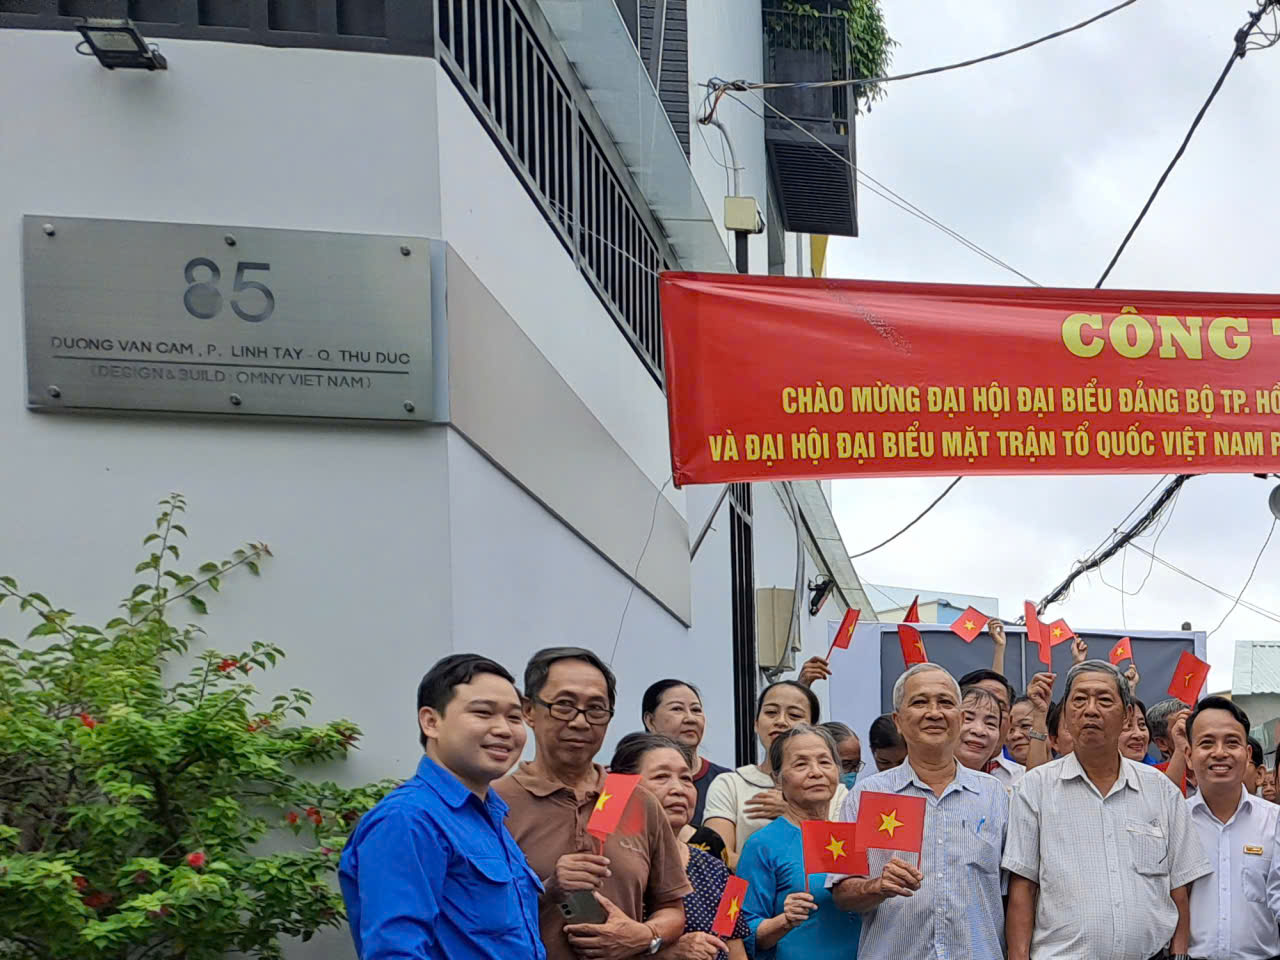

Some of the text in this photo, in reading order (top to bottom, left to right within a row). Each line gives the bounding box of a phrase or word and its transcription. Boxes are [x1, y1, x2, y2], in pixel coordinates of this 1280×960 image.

[183, 257, 275, 323] 85
[52, 336, 114, 351] DUONG
[117, 339, 152, 353] VAN
[231, 345, 268, 359] LINH
[273, 347, 303, 360] TAY
[340, 350, 371, 363] THU
[376, 352, 411, 364] DUC
[1061, 305, 1251, 361] CÔNG
[236, 371, 288, 385] OMNY
[782, 381, 844, 414] CHÀO
[851, 381, 921, 413] MỪNG
[927, 386, 965, 418] ĐẠI
[972, 381, 1010, 418] HỘI
[1017, 387, 1054, 418] ĐẠI
[1061, 378, 1112, 413] BIỂU
[1118, 380, 1179, 413] ĐẢNG
[1185, 384, 1214, 419] BỘ
[1220, 389, 1250, 414] TP.
[708, 429, 739, 461] VÀ
[745, 433, 784, 466] ĐẠI
[791, 427, 830, 465] HỘI
[836, 432, 875, 464] ĐẠI
[882, 420, 935, 460] BIỂU
[941, 426, 990, 463] MẶT
[997, 426, 1056, 462] TRẬN
[1062, 421, 1090, 457] TỔ
[1096, 422, 1155, 459] QUỐC
[1161, 426, 1207, 461] VIỆT
[1213, 431, 1264, 456] NAM
